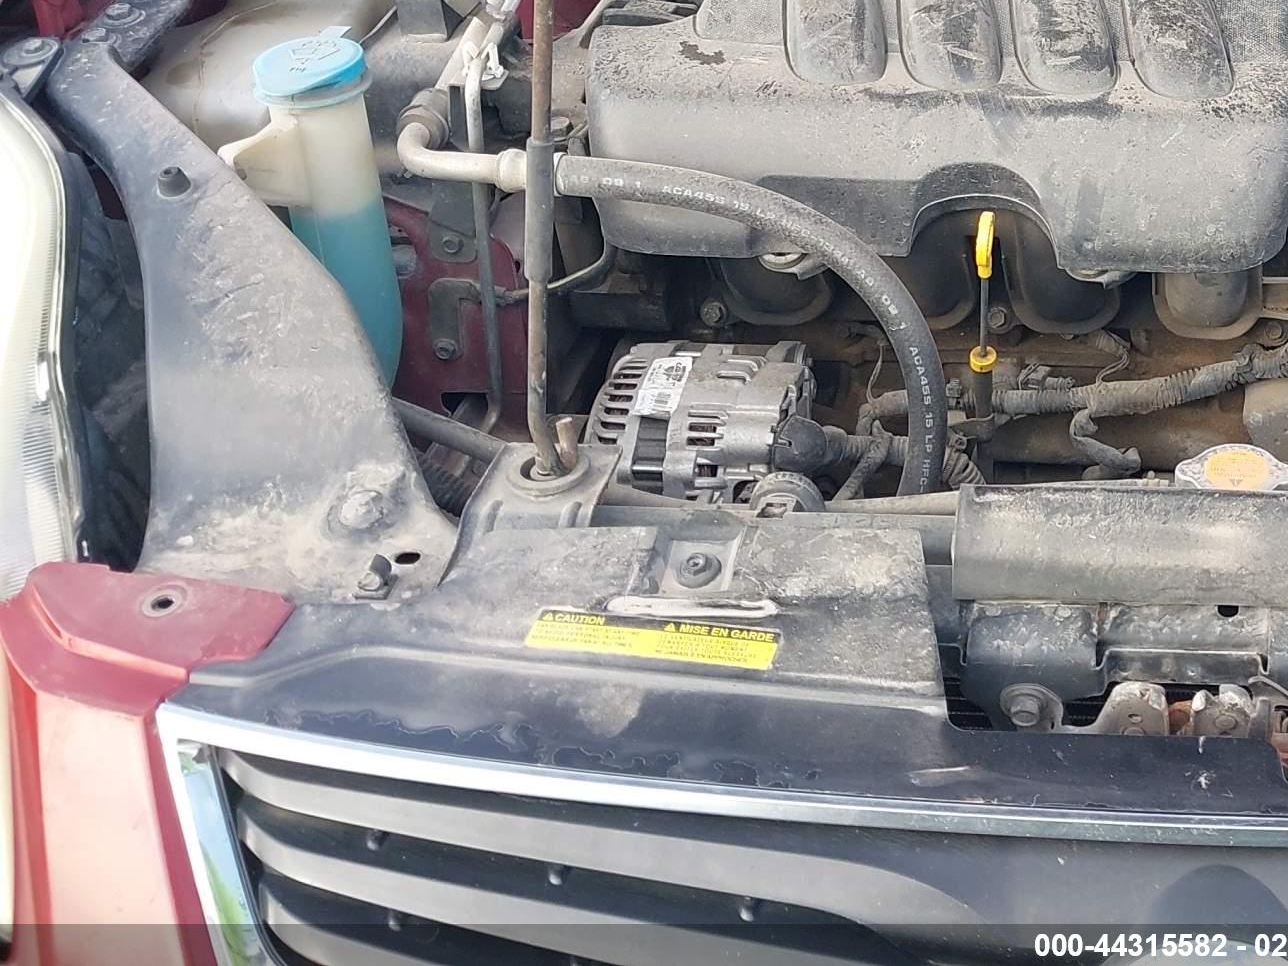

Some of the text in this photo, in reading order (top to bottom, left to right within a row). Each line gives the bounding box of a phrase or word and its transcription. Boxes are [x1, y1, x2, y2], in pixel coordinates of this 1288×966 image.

[554, 613, 606, 626] CAUTION
[678, 624, 709, 636] MISE
[710, 627, 730, 638] EN
[730, 629, 776, 643] GARDE
